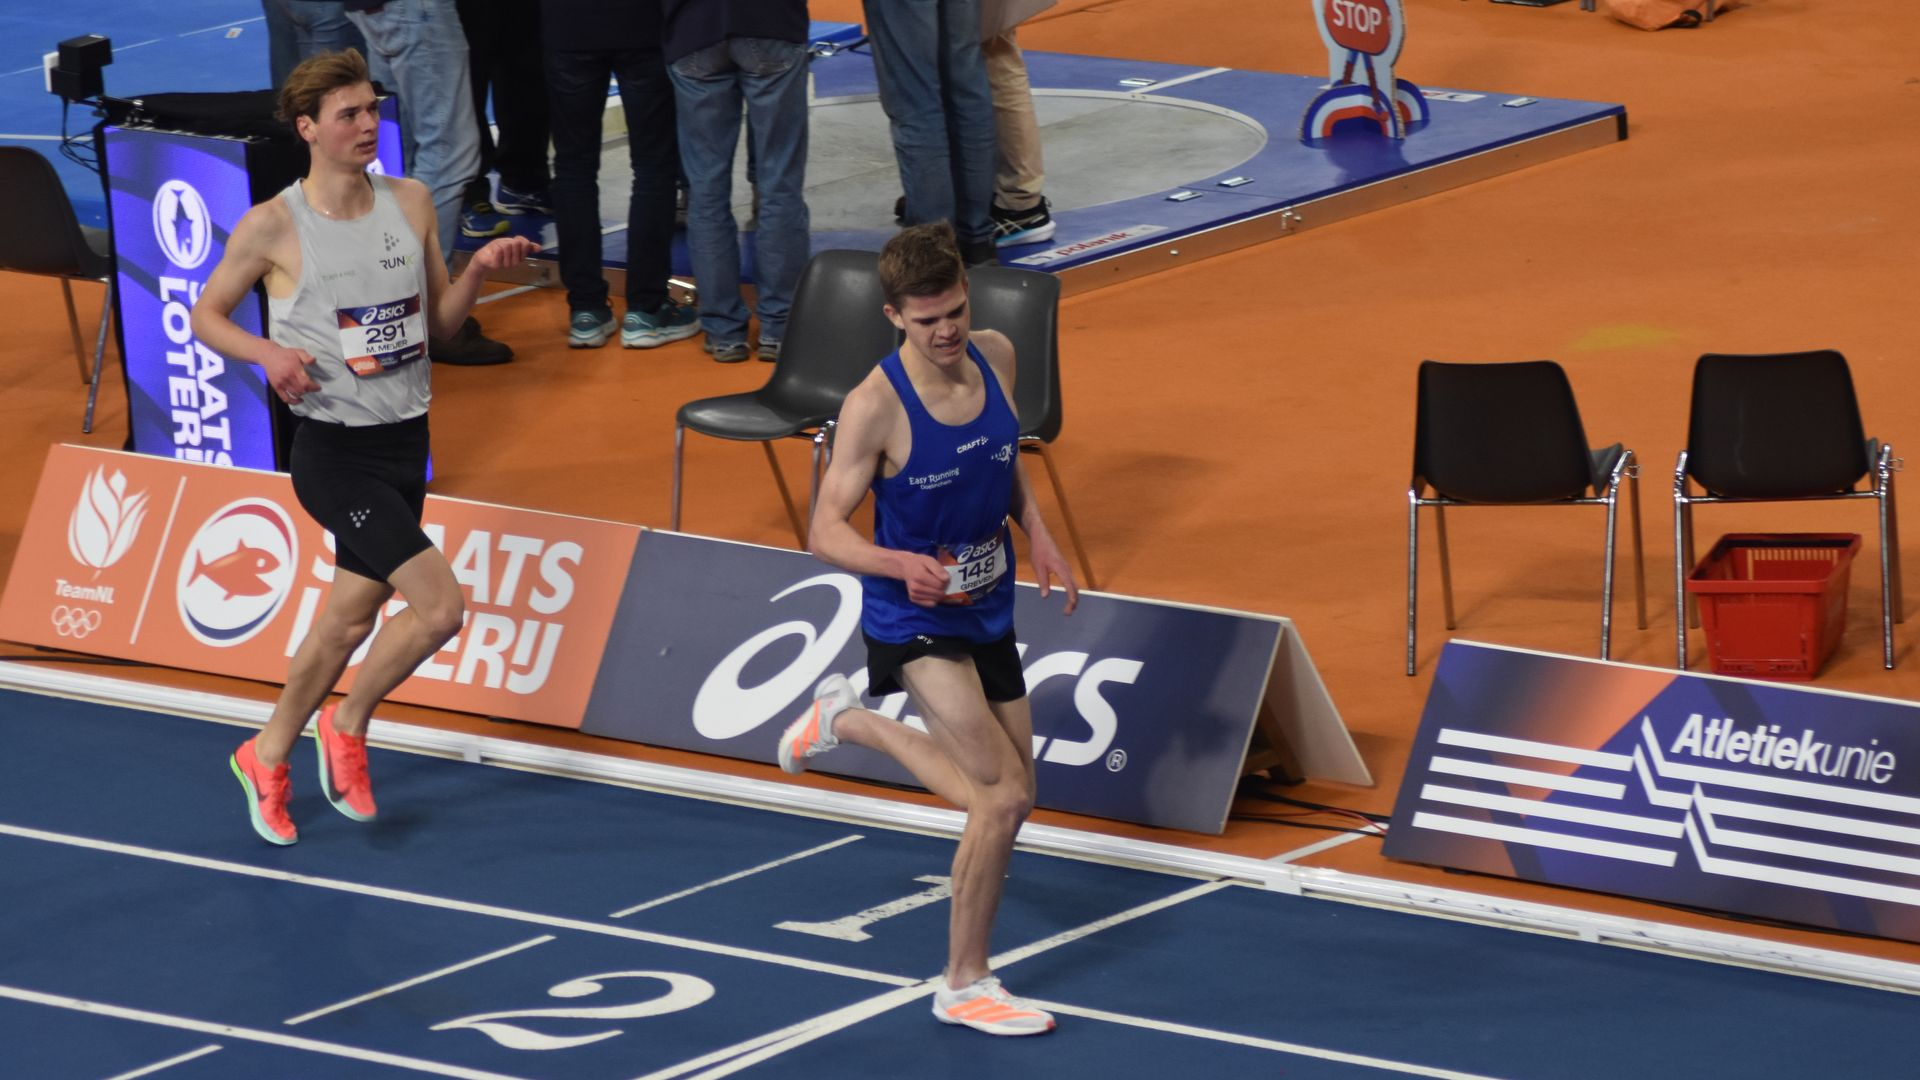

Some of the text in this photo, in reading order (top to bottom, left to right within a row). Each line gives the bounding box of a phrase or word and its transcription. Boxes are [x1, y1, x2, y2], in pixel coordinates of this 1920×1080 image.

[1332, 1, 1382, 34] STOP
[365, 321, 405, 345] 291
[159, 276, 204, 461] LOTERI
[188, 281, 233, 466] AAT
[957, 438, 981, 454] CRAFT
[909, 467, 960, 486] Easy Running
[311, 523, 584, 615] ATS
[958, 556, 996, 582] 148
[960, 575, 994, 591] GREVEN
[55, 579, 114, 604] TeamNL
[1670, 713, 1897, 784] Atletiekunie
[429, 970, 715, 1050] 2
